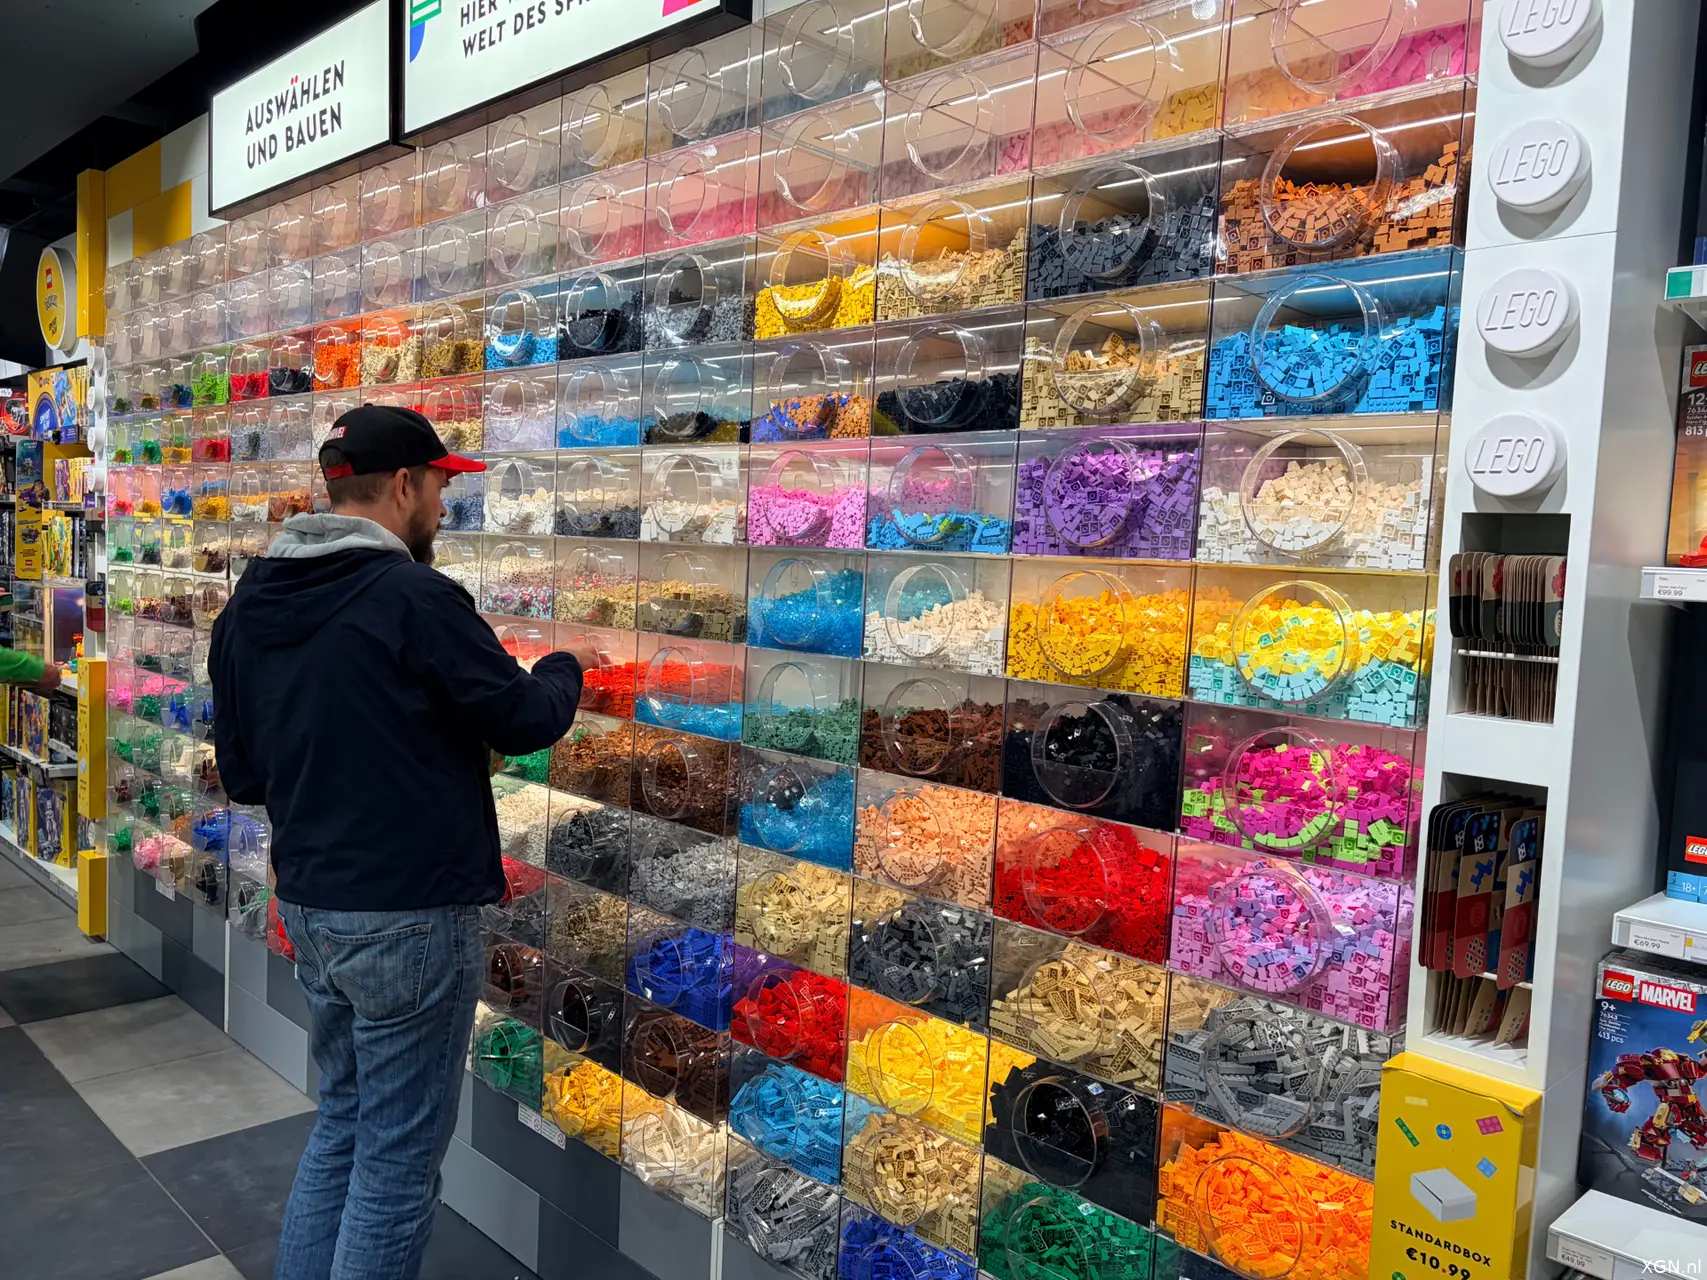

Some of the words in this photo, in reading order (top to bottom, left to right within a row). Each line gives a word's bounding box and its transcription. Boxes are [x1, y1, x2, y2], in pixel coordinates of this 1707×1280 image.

[460, 0, 498, 28] HIER
[1507, 0, 1578, 37] LEGO
[462, 19, 507, 58] WELT
[513, 0, 547, 35] DES
[245, 59, 345, 136] AUSWÄHLEN
[246, 133, 278, 169] UND
[285, 101, 342, 153] BAUEN
[1496, 138, 1569, 185] LEGO
[1484, 289, 1557, 331] LEGO
[1687, 393, 1707, 406] 12
[1685, 426, 1703, 436] 813
[1473, 437, 1545, 474] LEGO
[1687, 844, 1707, 856] LEG
[1682, 881, 1697, 893] 18+
[1633, 938, 1661, 949] €69.99
[1605, 979, 1632, 993] LEGO
[1640, 983, 1695, 1013] MARVEL
[1600, 1001, 1617, 1011] 9+
[1598, 1031, 1611, 1040] 413
[1611, 1035, 1625, 1044] pcs
[1390, 1219, 1492, 1267] STANDARDBOX
[1405, 1247, 1471, 1280] €10.99
[1561, 1253, 1586, 1268] €49.99
